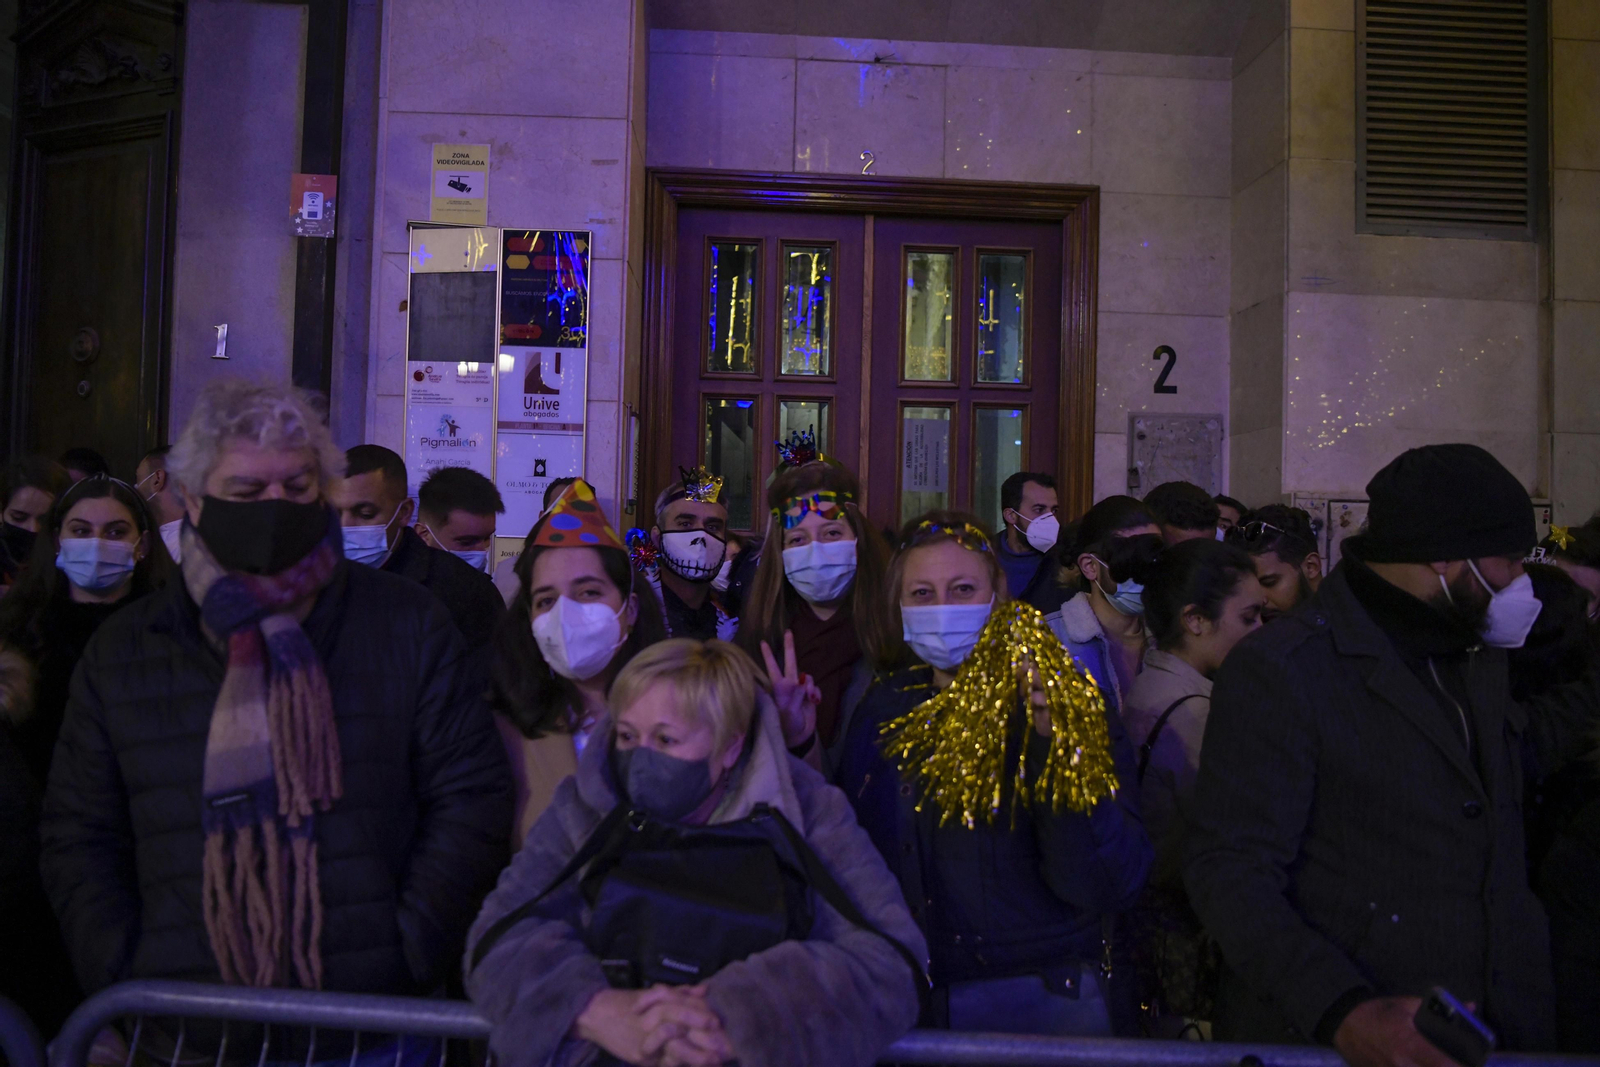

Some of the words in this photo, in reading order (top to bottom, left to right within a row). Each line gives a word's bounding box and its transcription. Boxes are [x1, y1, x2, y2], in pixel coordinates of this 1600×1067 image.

[860, 150, 876, 176] 2
[211, 323, 230, 358] 1
[1152, 345, 1182, 394] 2
[524, 396, 560, 411] Unive
[420, 437, 476, 449] Pigmalión
